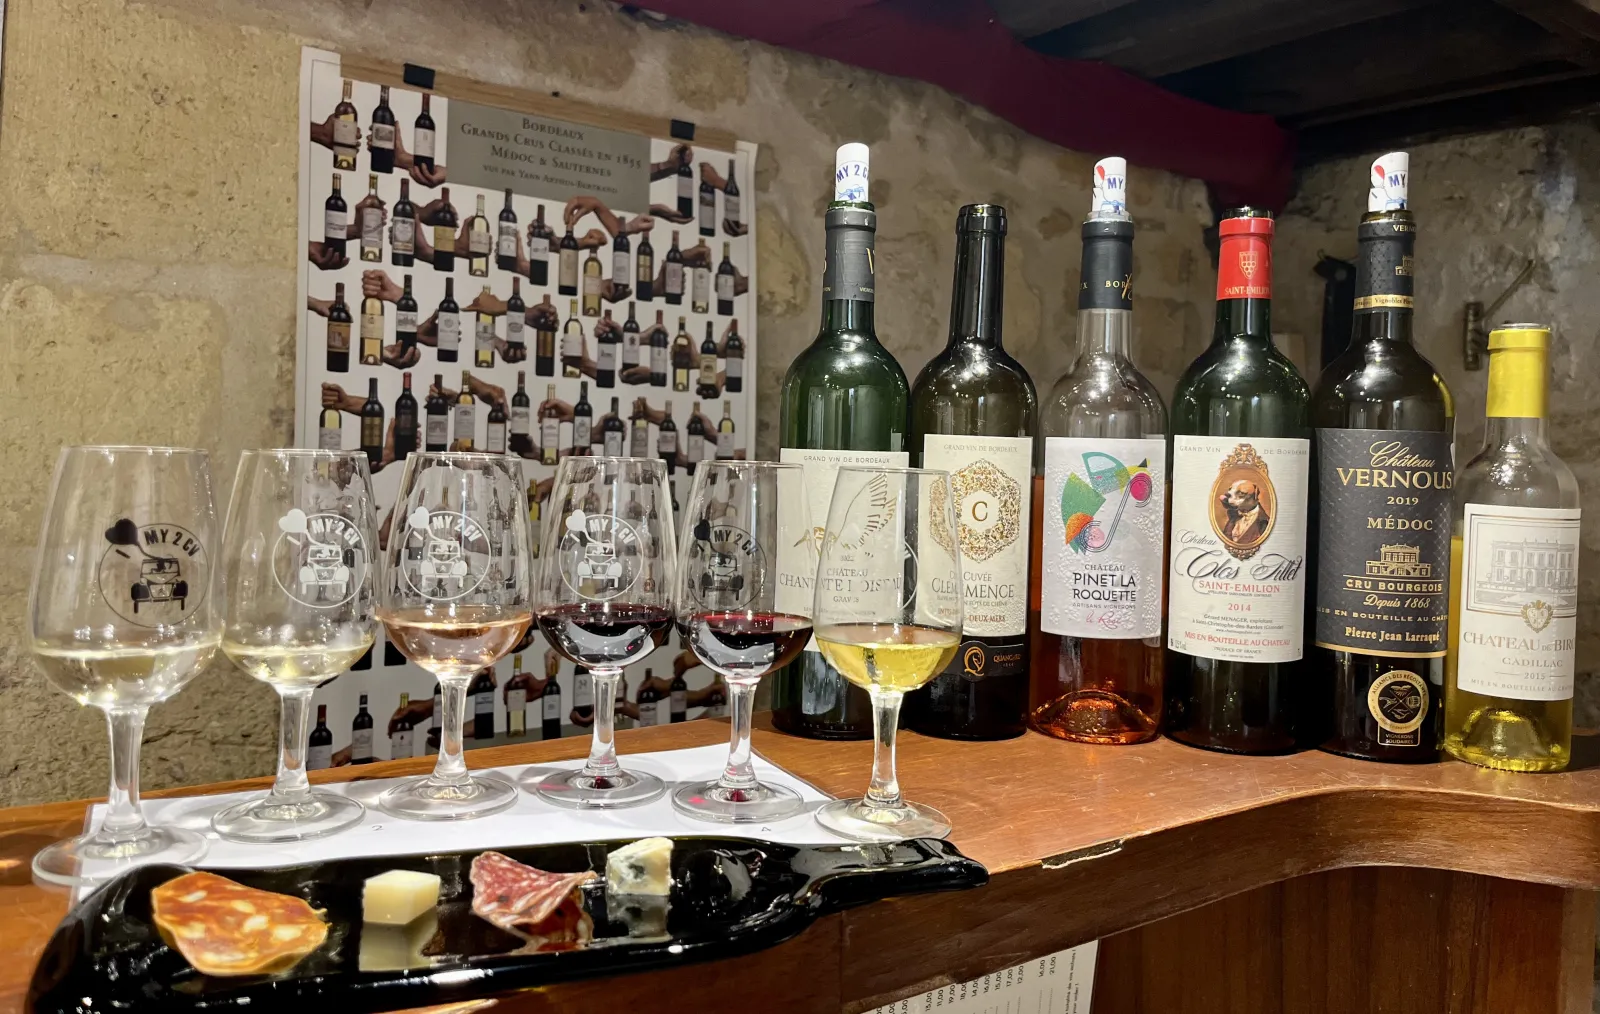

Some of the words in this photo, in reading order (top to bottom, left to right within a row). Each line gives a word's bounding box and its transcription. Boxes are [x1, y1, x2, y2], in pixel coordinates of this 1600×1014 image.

[539, 158, 547, 166] &
[616, 156, 642, 170] 1855
[836, 165, 849, 183] MY
[1107, 174, 1124, 189] MY
[1388, 173, 1406, 188] MY
[1369, 440, 1436, 468] Château
[1336, 467, 1452, 490] VERNOUS
[1386, 496, 1419, 506] 2019
[971, 501, 988, 522] C
[311, 518, 333, 534] MY
[432, 515, 453, 530] MY
[589, 518, 609, 533] MY
[1366, 514, 1433, 531] MÉDOC
[144, 528, 169, 546] MY
[713, 529, 732, 543] MY
[1072, 572, 1117, 588] PINET
[1120, 574, 1136, 587] LA
[1199, 580, 1281, 593] SAINT-EMILION
[1346, 579, 1372, 589] CRU
[1378, 582, 1443, 592] BOURGEOIS
[1072, 588, 1136, 602] ROQUETTE
[1363, 594, 1401, 610] Depuis
[1404, 597, 1431, 609] 1868
[1228, 603, 1252, 612] 2014
[1334, 609, 1348, 617] EN
[1353, 611, 1413, 622] BOUTEILLE
[1197, 632, 1206, 641] EN
[1207, 634, 1249, 646] BOUTEILLE
[1344, 626, 1377, 639] Pierre
[1378, 630, 1402, 642] Jean
[1502, 657, 1563, 668] CADILLAC
[1524, 672, 1546, 680] 2015
